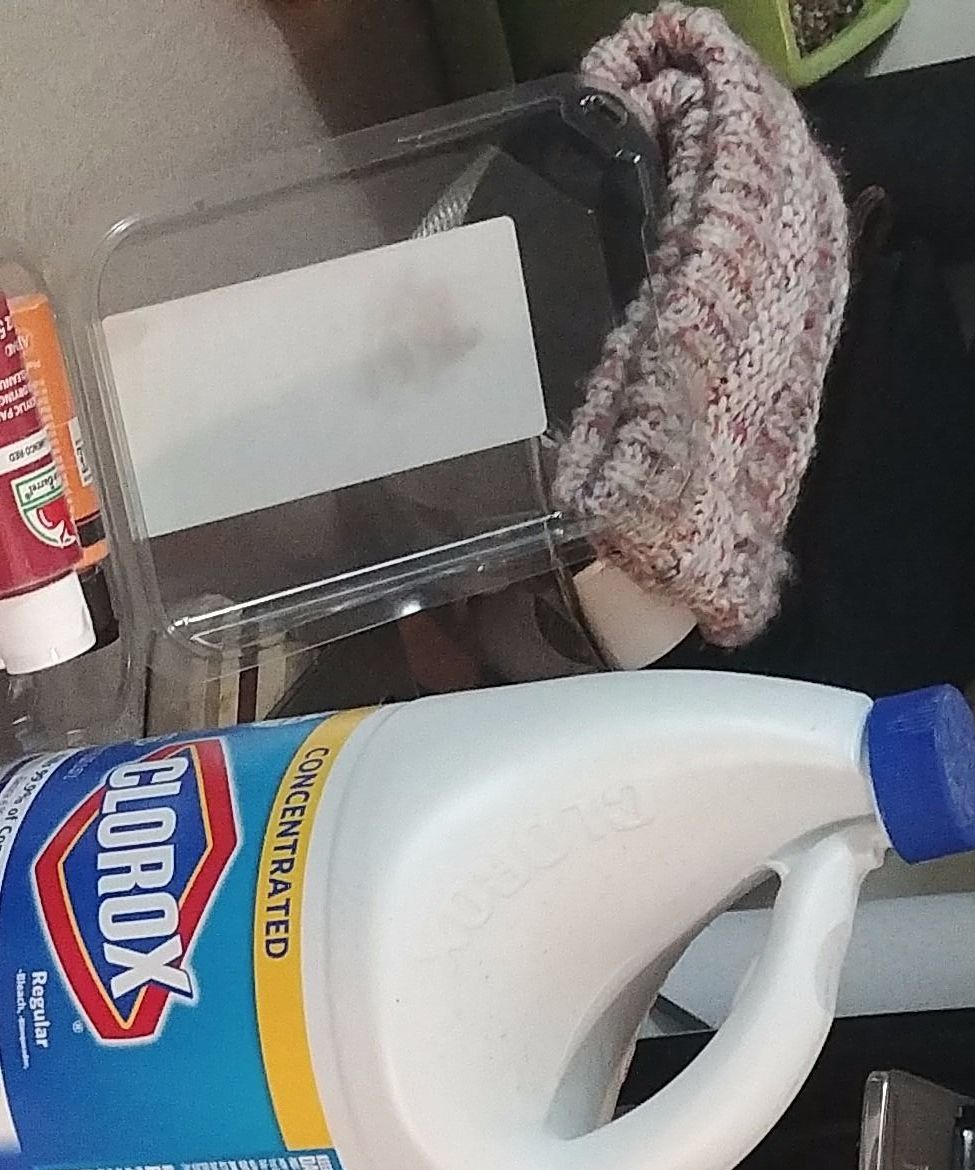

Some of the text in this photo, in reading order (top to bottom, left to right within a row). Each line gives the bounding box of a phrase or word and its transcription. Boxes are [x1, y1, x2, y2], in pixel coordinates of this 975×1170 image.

[97, 757, 194, 1000] CLOROX
[265, 747, 330, 959] CONCENTRATED
[29, 970, 52, 1049] Regular
